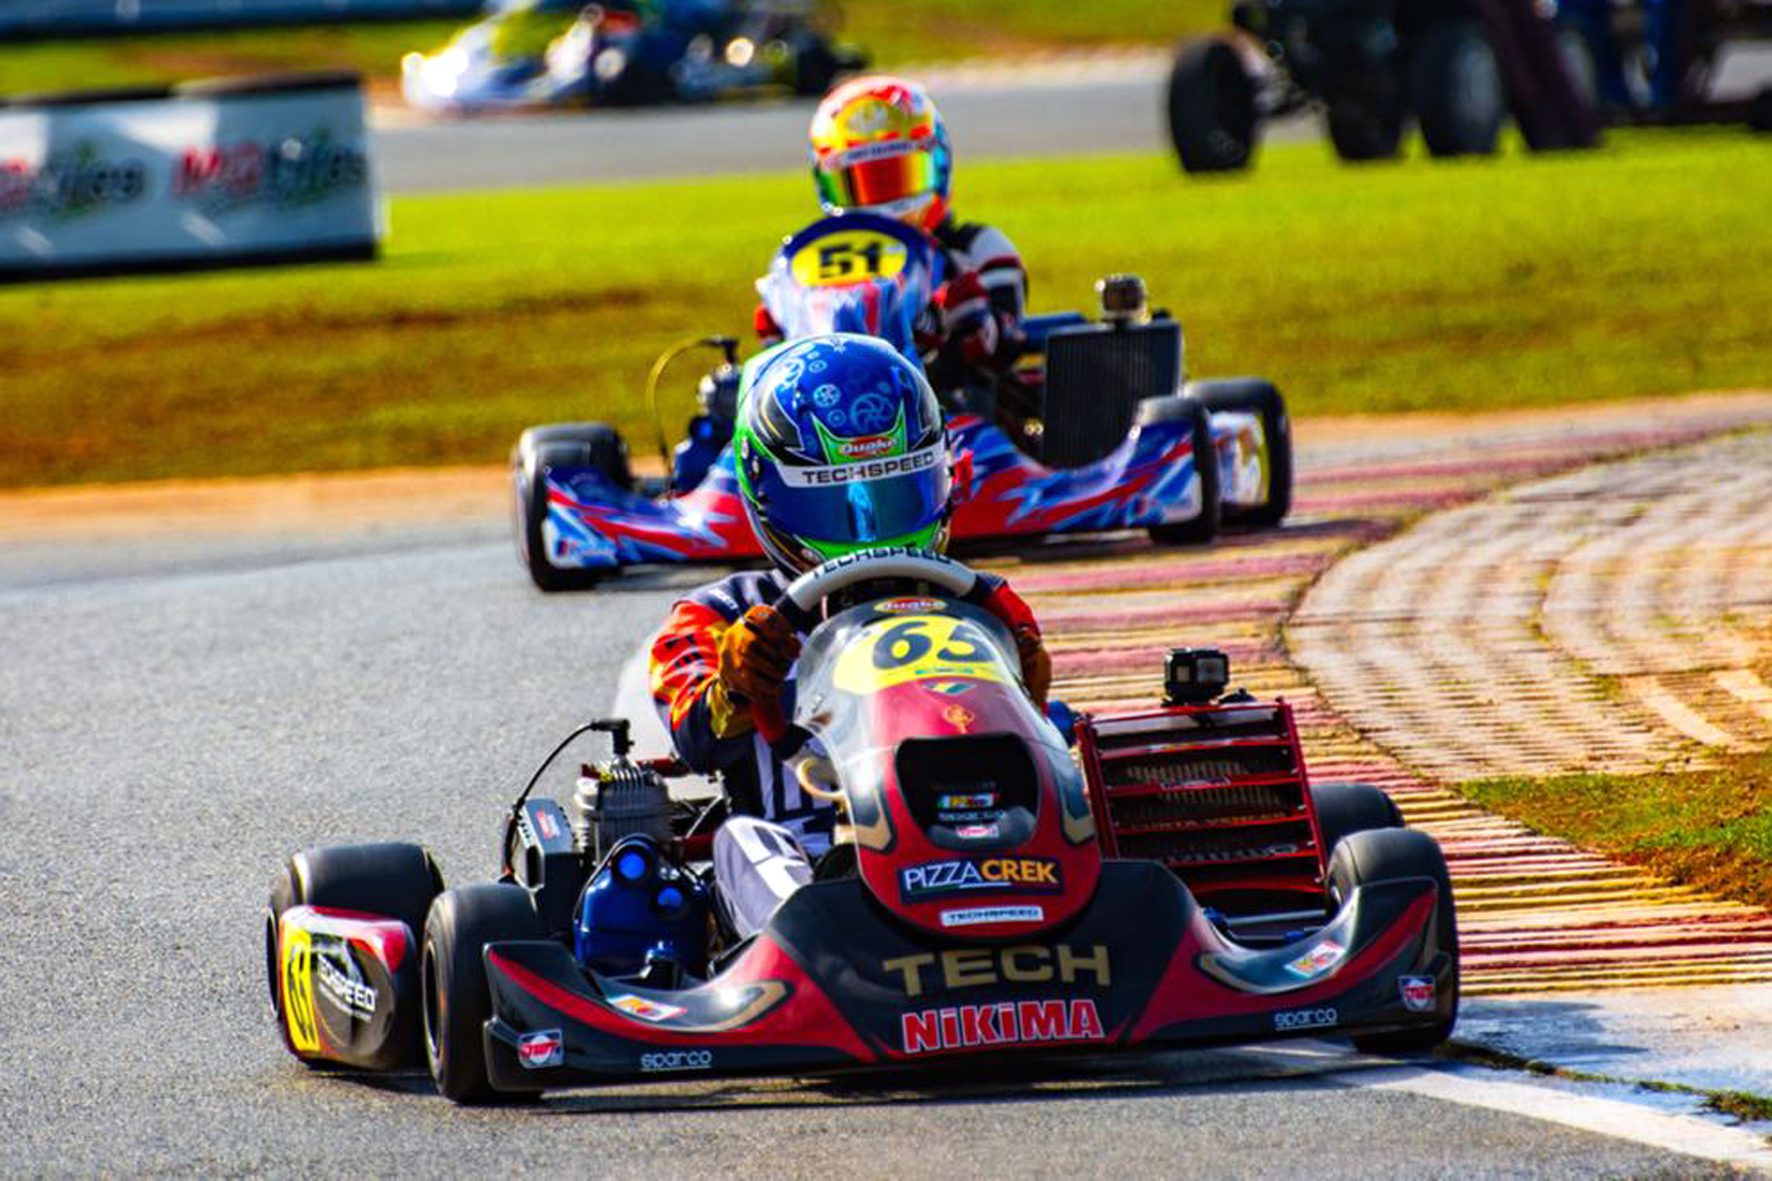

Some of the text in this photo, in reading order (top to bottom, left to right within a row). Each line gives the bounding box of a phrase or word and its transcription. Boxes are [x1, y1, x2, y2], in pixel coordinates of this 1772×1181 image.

[819, 241, 881, 280] 51
[802, 451, 934, 484] TECHSPEED
[883, 944, 1111, 997] TECH
[1274, 1007, 1338, 1028] sparco
[640, 1050, 713, 1070] sparco
